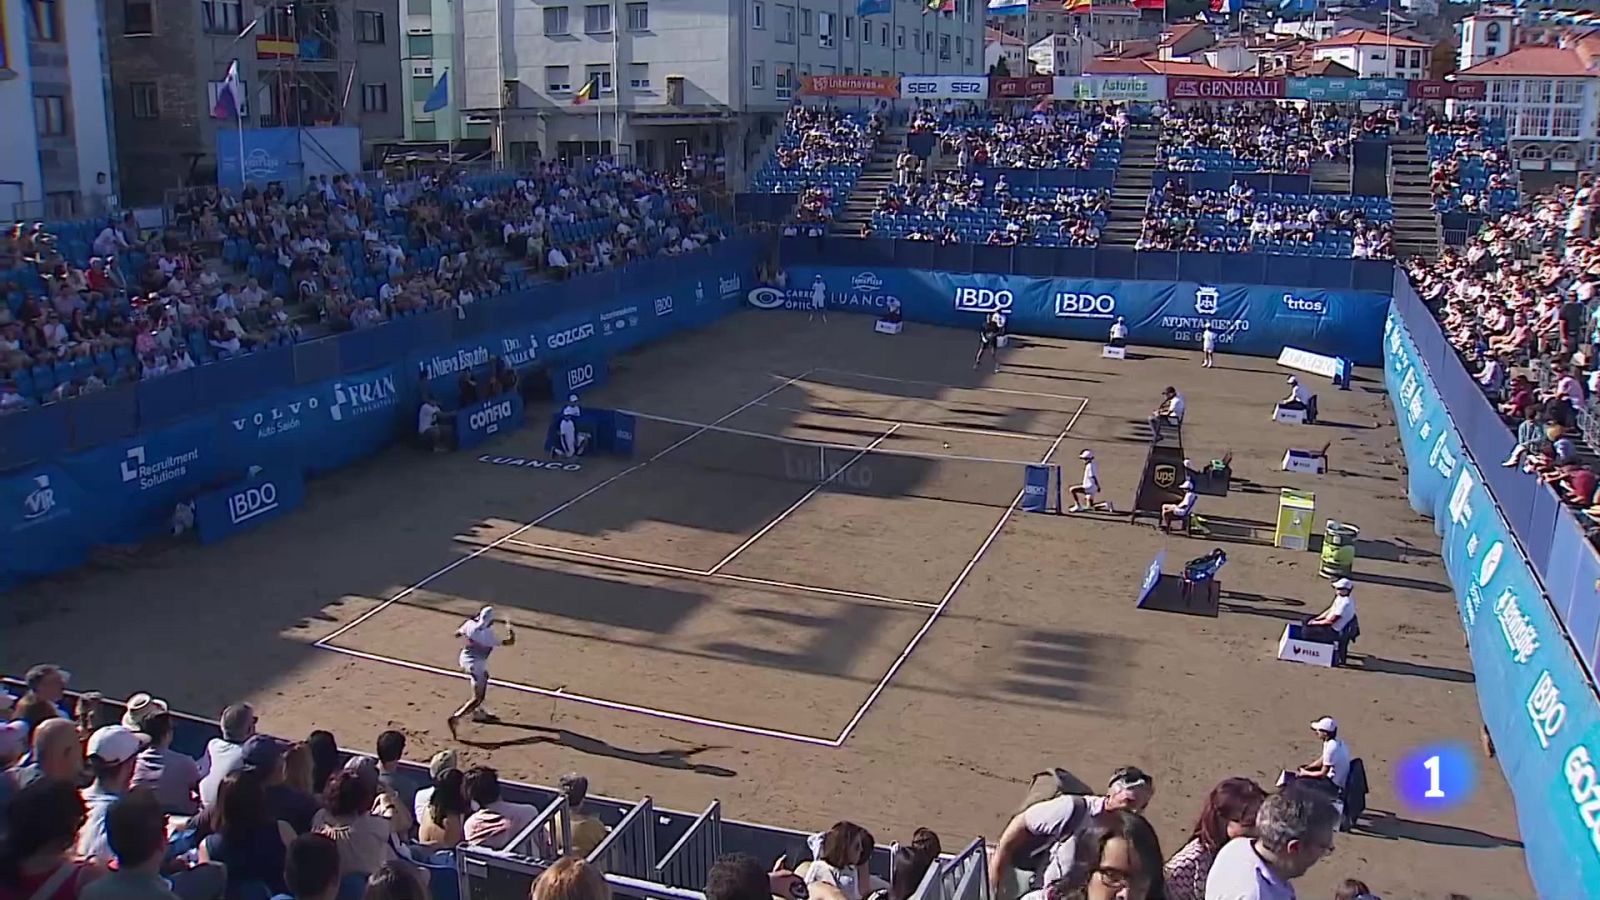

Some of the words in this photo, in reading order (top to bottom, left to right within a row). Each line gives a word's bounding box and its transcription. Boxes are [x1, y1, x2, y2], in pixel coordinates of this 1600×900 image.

[908, 82, 938, 94] SER
[951, 82, 981, 94] SER
[1102, 79, 1148, 92] Asturias
[1200, 81, 1280, 97] GENERALI
[831, 291, 886, 307] LUANC
[961, 288, 1012, 309] BDO
[1062, 294, 1115, 313] BDO
[547, 323, 595, 350] GOZCAR
[1174, 331, 1191, 341] DE
[432, 356, 459, 379] Nueva
[459, 347, 489, 372] España
[570, 364, 594, 386] BDO
[348, 376, 396, 407] FRAN
[233, 397, 319, 431] VOLVO
[258, 425, 276, 439] Auto
[138, 448, 199, 480] Recruitment
[477, 455, 582, 471] LUANCO
[140, 466, 187, 491] Solutions
[1156, 471, 1175, 485] ups
[234, 482, 277, 519] BDO
